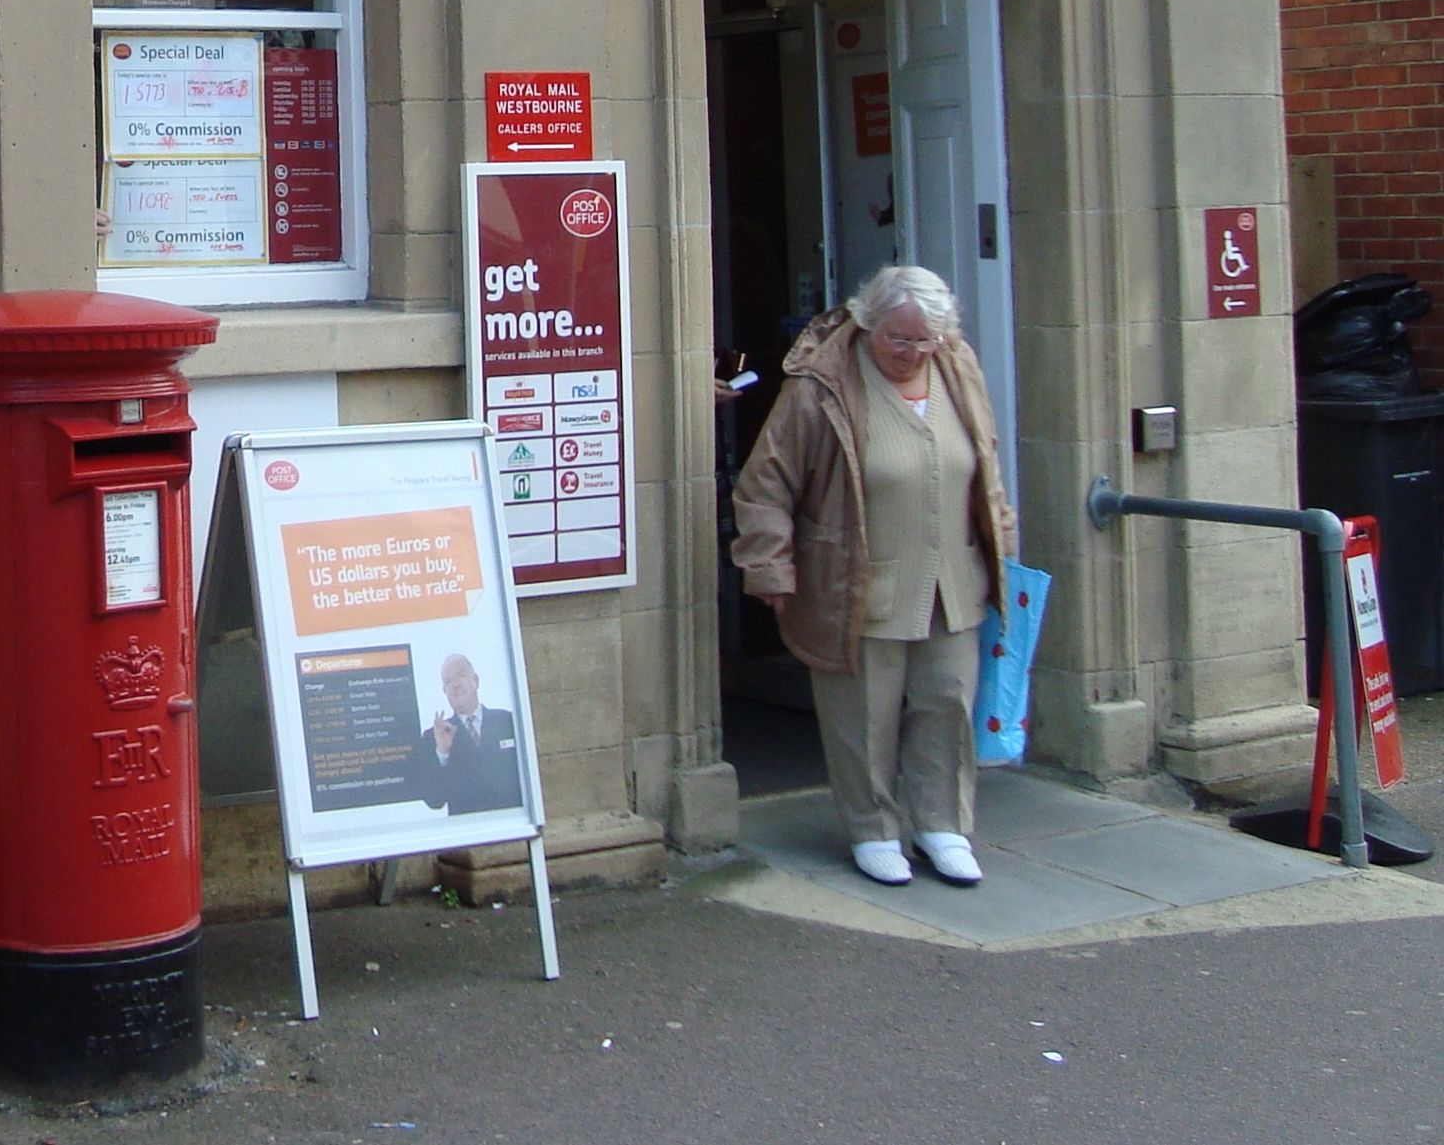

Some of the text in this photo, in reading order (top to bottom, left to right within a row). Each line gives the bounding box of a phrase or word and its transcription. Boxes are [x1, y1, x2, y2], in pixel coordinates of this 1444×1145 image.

[139, 45, 190, 62] Special
[195, 45, 224, 60] Deal
[499, 83, 580, 97] ROYAL MAIL
[496, 99, 583, 114] WESTBOURNE
[128, 121, 242, 136] 0% Commission
[497, 122, 583, 135] CALLERS OFFICE
[572, 199, 601, 213] POST
[566, 211, 605, 225] OFFICE
[126, 228, 245, 244] 0% Commission
[484, 258, 540, 302] get
[484, 308, 604, 341] more...
[485, 346, 604, 361] services available in this branch
[571, 383, 598, 398] ns&i
[583, 440, 602, 449] Travel
[583, 449, 603, 458] Money
[271, 465, 292, 475] POST
[584, 472, 603, 480] Travel
[267, 473, 297, 484] OFFICE
[106, 512, 134, 523] 6.00pm
[341, 545, 382, 561] more
[385, 536, 431, 556] Euros
[434, 534, 451, 551] or
[107, 554, 141, 565] 12.45pm
[308, 556, 457, 587] US dollars you buy,
[312, 592, 339, 609] the
[343, 587, 392, 606] better
[395, 583, 421, 600] the
[315, 658, 363, 671] Departures
[90, 803, 175, 840] ROYAL
[101, 831, 171, 867] MAIL
